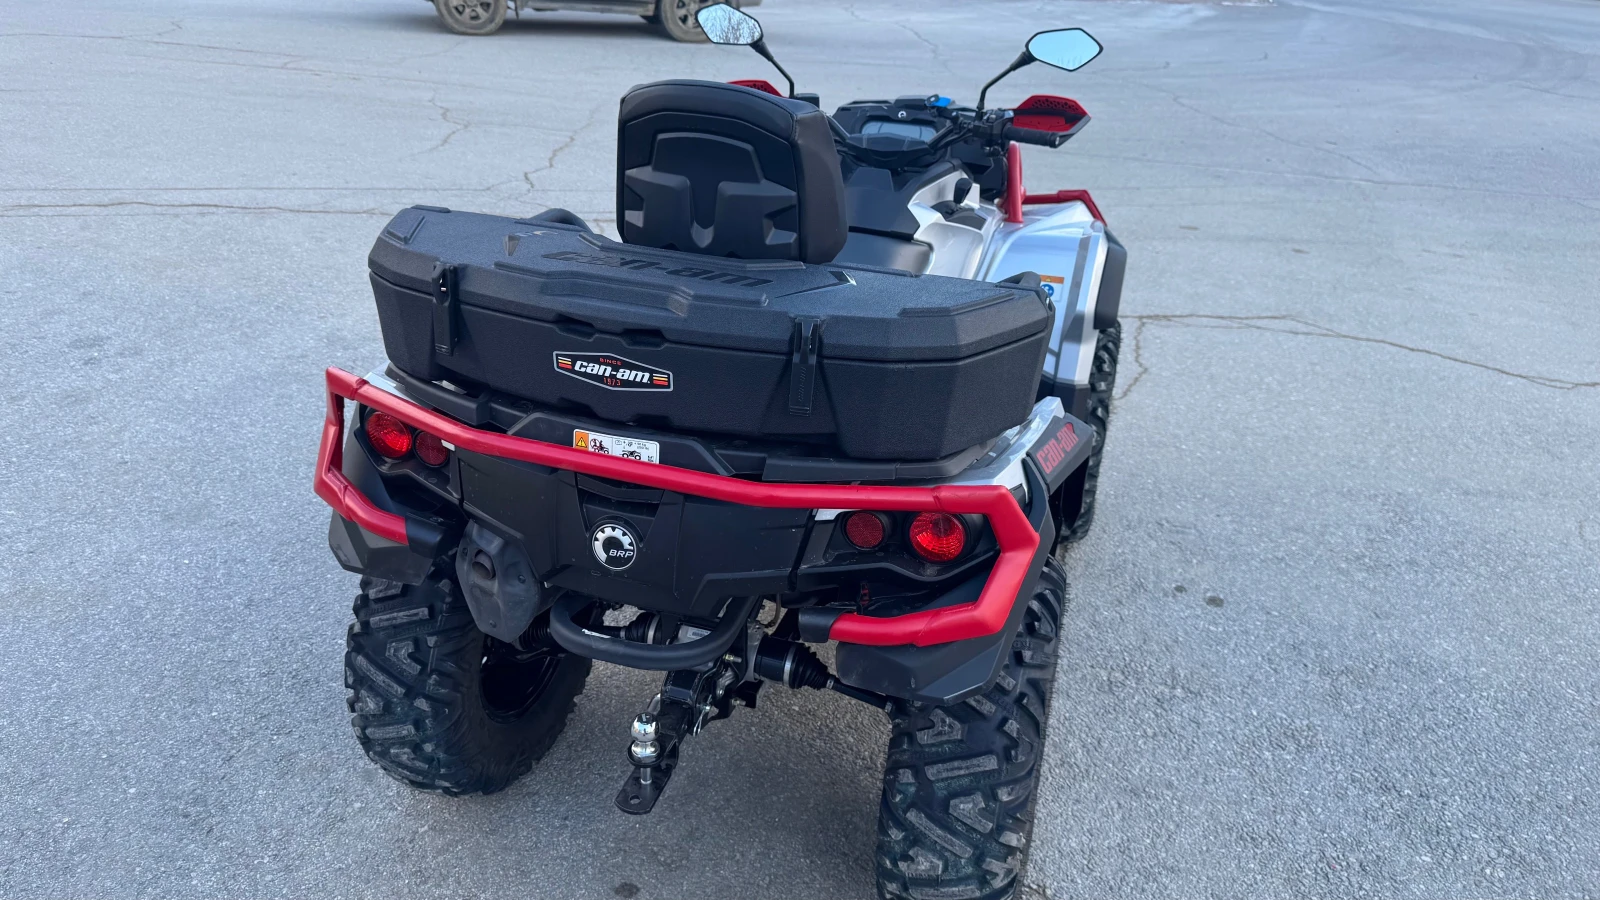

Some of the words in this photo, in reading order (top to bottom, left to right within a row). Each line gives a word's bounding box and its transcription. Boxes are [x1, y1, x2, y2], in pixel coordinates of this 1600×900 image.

[600, 357, 622, 366] SINCE
[603, 377, 621, 386] 1973
[609, 549, 634, 558] BRP
